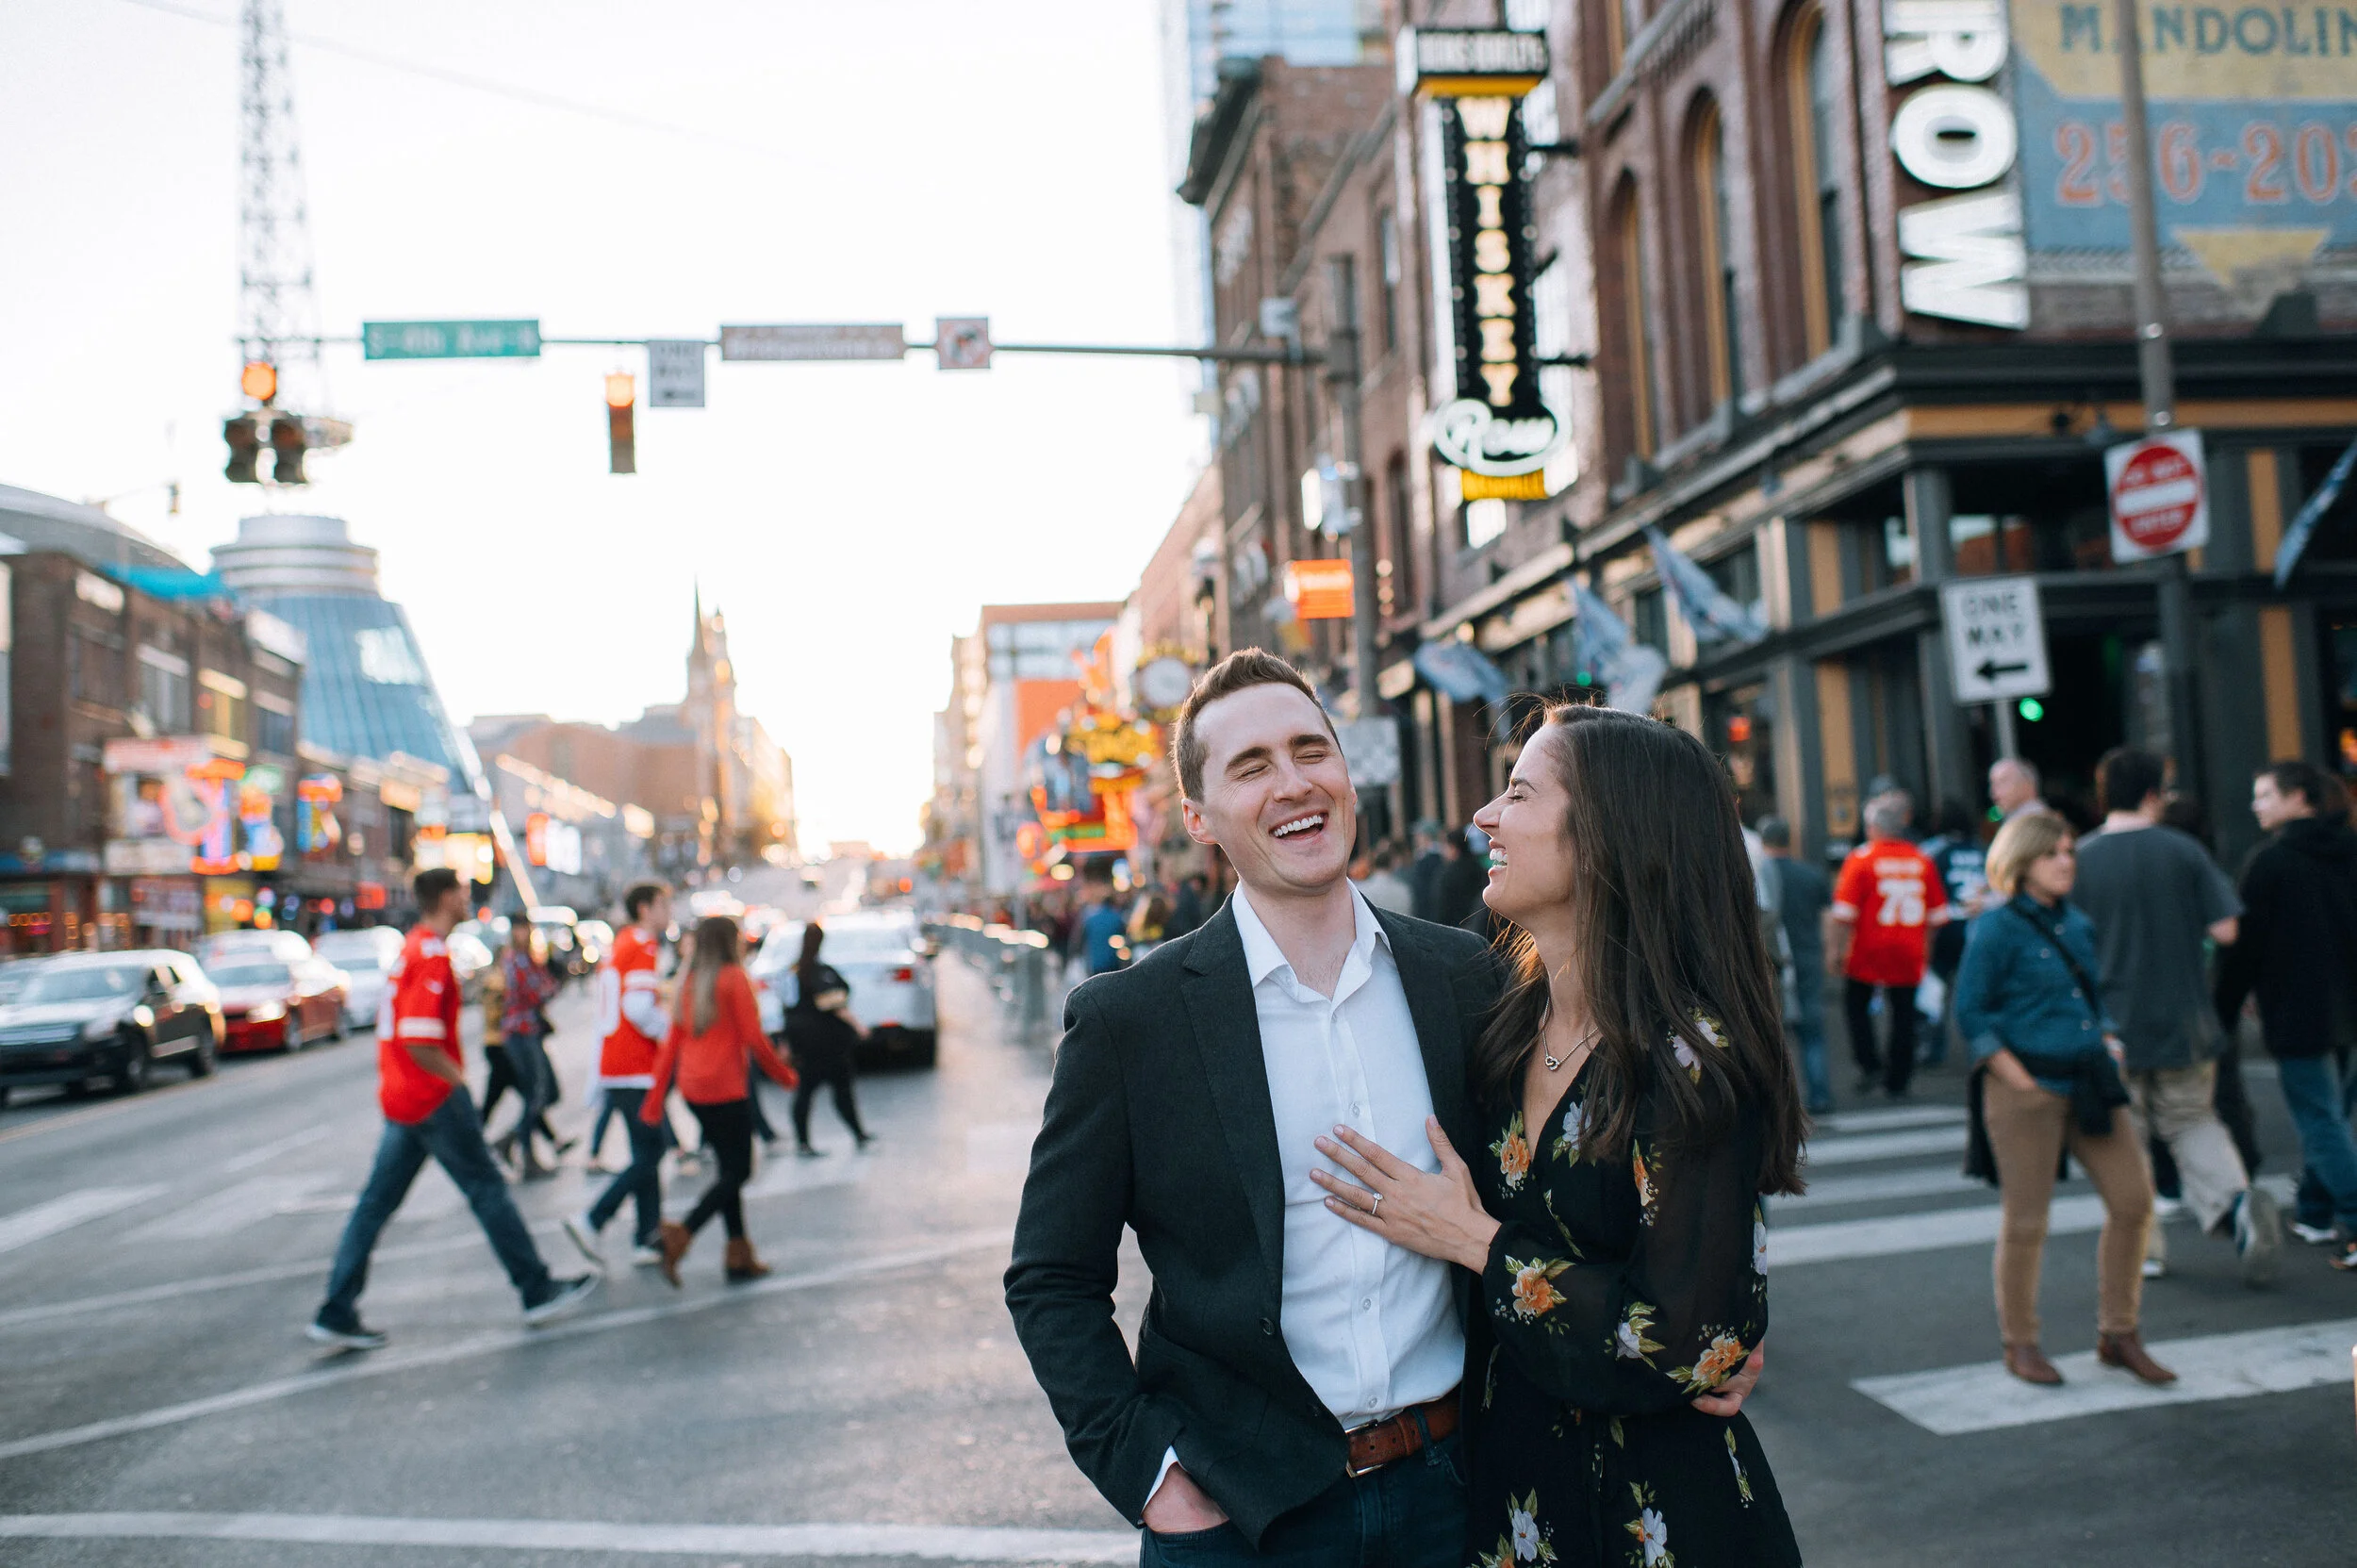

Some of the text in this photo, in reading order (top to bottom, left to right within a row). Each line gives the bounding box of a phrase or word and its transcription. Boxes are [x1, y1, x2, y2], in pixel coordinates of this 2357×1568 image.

[2060, 5, 2357, 57] MNDOLIN
[1455, 96, 1520, 407] WHISKEY
[1885, 0, 2031, 330] ROW
[1964, 590, 2022, 619] ONE
